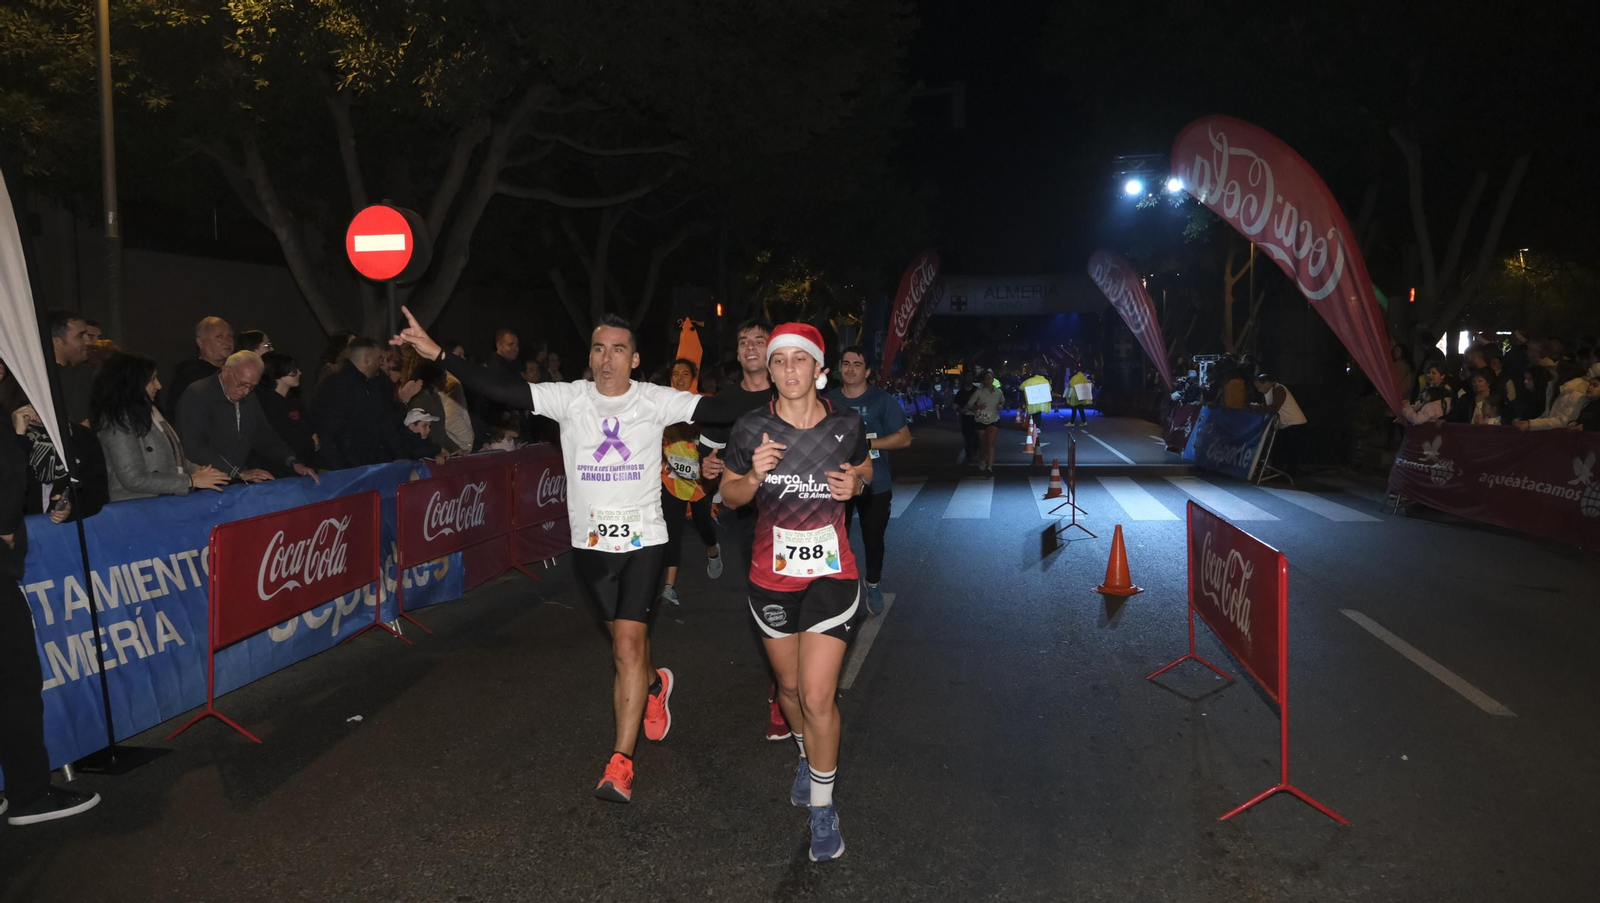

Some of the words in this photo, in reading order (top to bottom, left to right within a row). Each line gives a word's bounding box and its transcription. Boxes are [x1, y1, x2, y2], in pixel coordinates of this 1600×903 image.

[894, 255, 936, 337] Coca-Cola
[983, 301, 1022, 310] CIUDAD
[581, 472, 611, 481] ARNOLD
[613, 471, 641, 481] CHIARI
[609, 464, 638, 472] ENFERMOS
[673, 462, 691, 473] 380
[1478, 471, 1582, 502] aquéatacamos
[423, 480, 487, 542] Coca-Cola
[597, 523, 630, 537] 923
[257, 514, 352, 601] Coca-Cola
[786, 544, 824, 560] 788
[18, 546, 210, 629] TAMIENT
[1202, 531, 1254, 640] Coca-Cola
